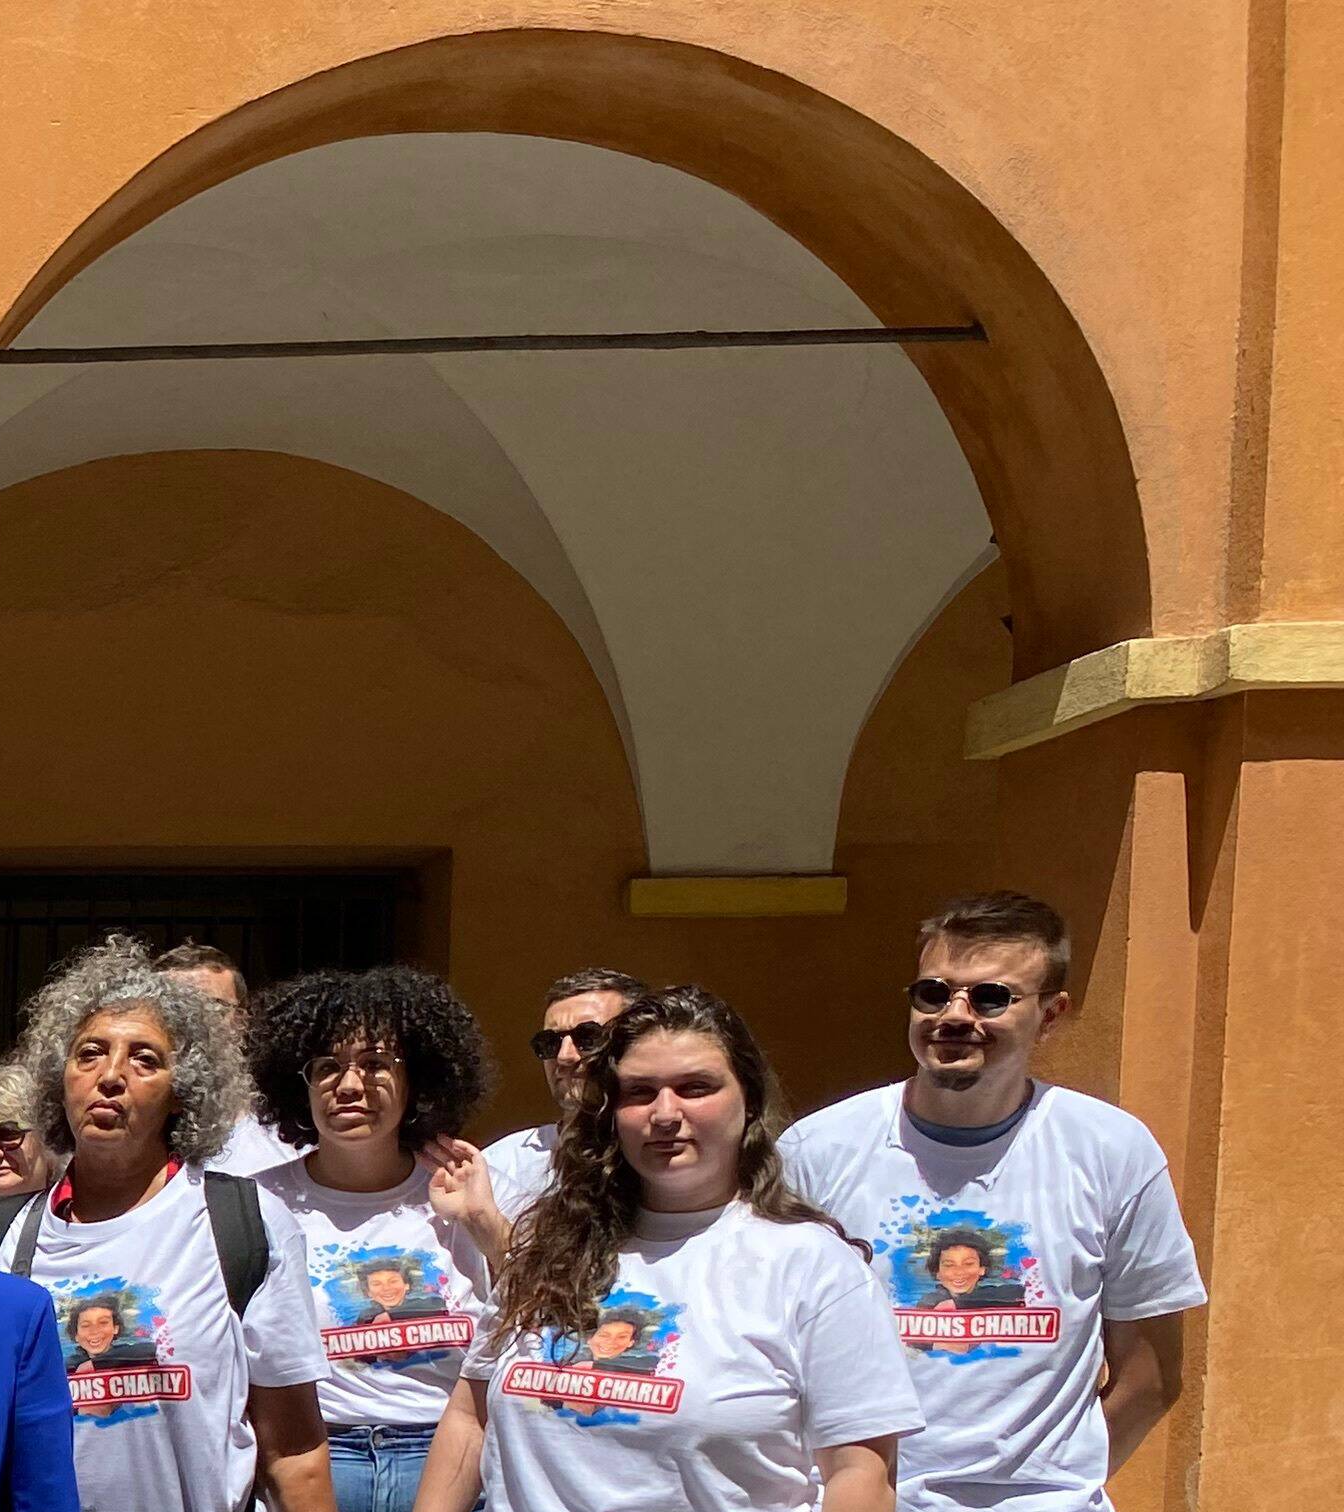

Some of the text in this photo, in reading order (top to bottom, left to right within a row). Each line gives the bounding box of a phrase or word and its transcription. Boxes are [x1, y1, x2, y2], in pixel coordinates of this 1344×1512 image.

[406, 1322, 468, 1345] CHARLY
[896, 1314, 1052, 1337] UVONS CHARLY
[108, 1372, 183, 1398] CHARLY
[510, 1368, 676, 1406] SAUVONS CHARLY
